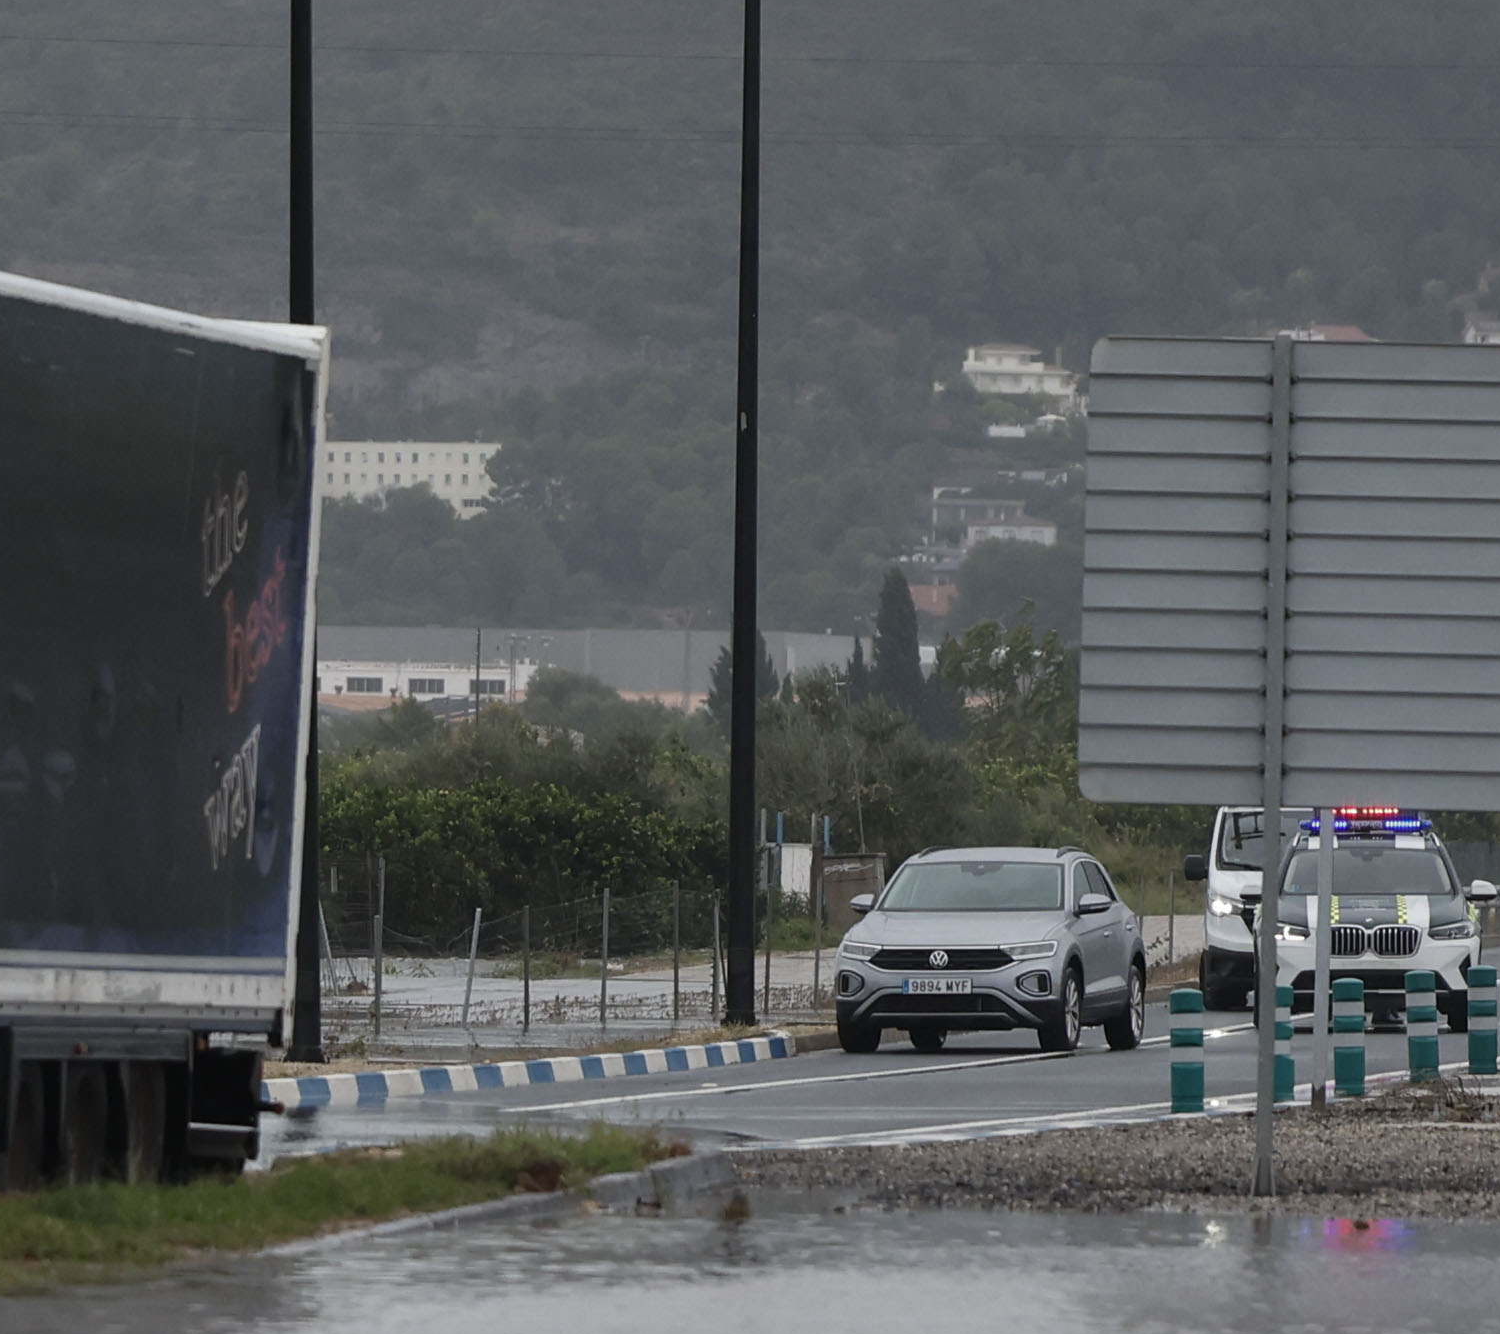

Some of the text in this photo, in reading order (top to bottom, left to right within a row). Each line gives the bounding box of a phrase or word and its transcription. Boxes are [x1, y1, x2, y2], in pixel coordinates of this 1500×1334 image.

[202, 470, 250, 598] the
[225, 545, 289, 714] best
[204, 722, 262, 871] way
[911, 980, 969, 992] 9894 MYF
